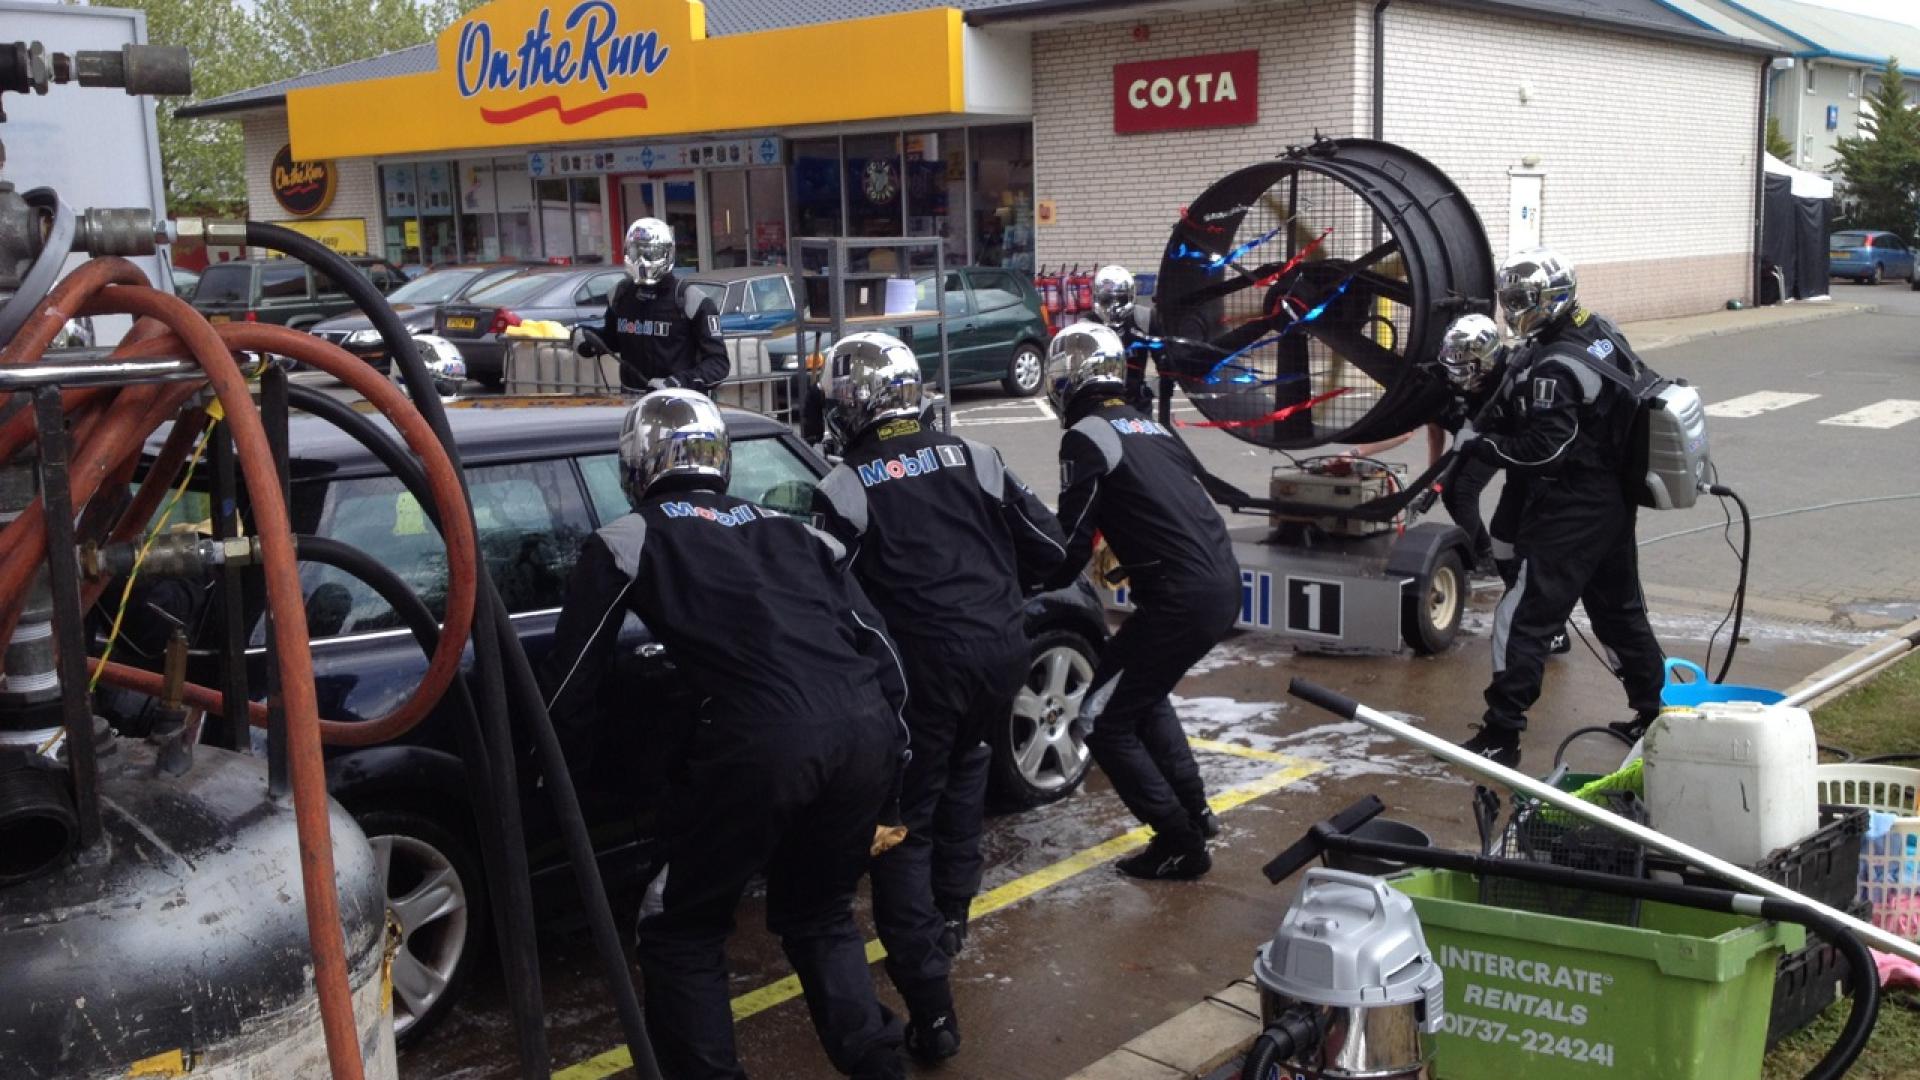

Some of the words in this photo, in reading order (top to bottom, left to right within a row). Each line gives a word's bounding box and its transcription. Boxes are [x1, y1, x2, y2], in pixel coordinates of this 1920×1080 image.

[457, 20, 517, 97] On
[516, 8, 577, 91] the
[565, 0, 669, 91] Run
[1128, 71, 1237, 109] COSTA
[618, 318, 653, 336] Mobil
[858, 447, 939, 487] Mobil
[660, 501, 757, 527] Mobil
[1464, 984, 1588, 1026] RENTALS
[1443, 1011, 1614, 1067] 01737-224241
